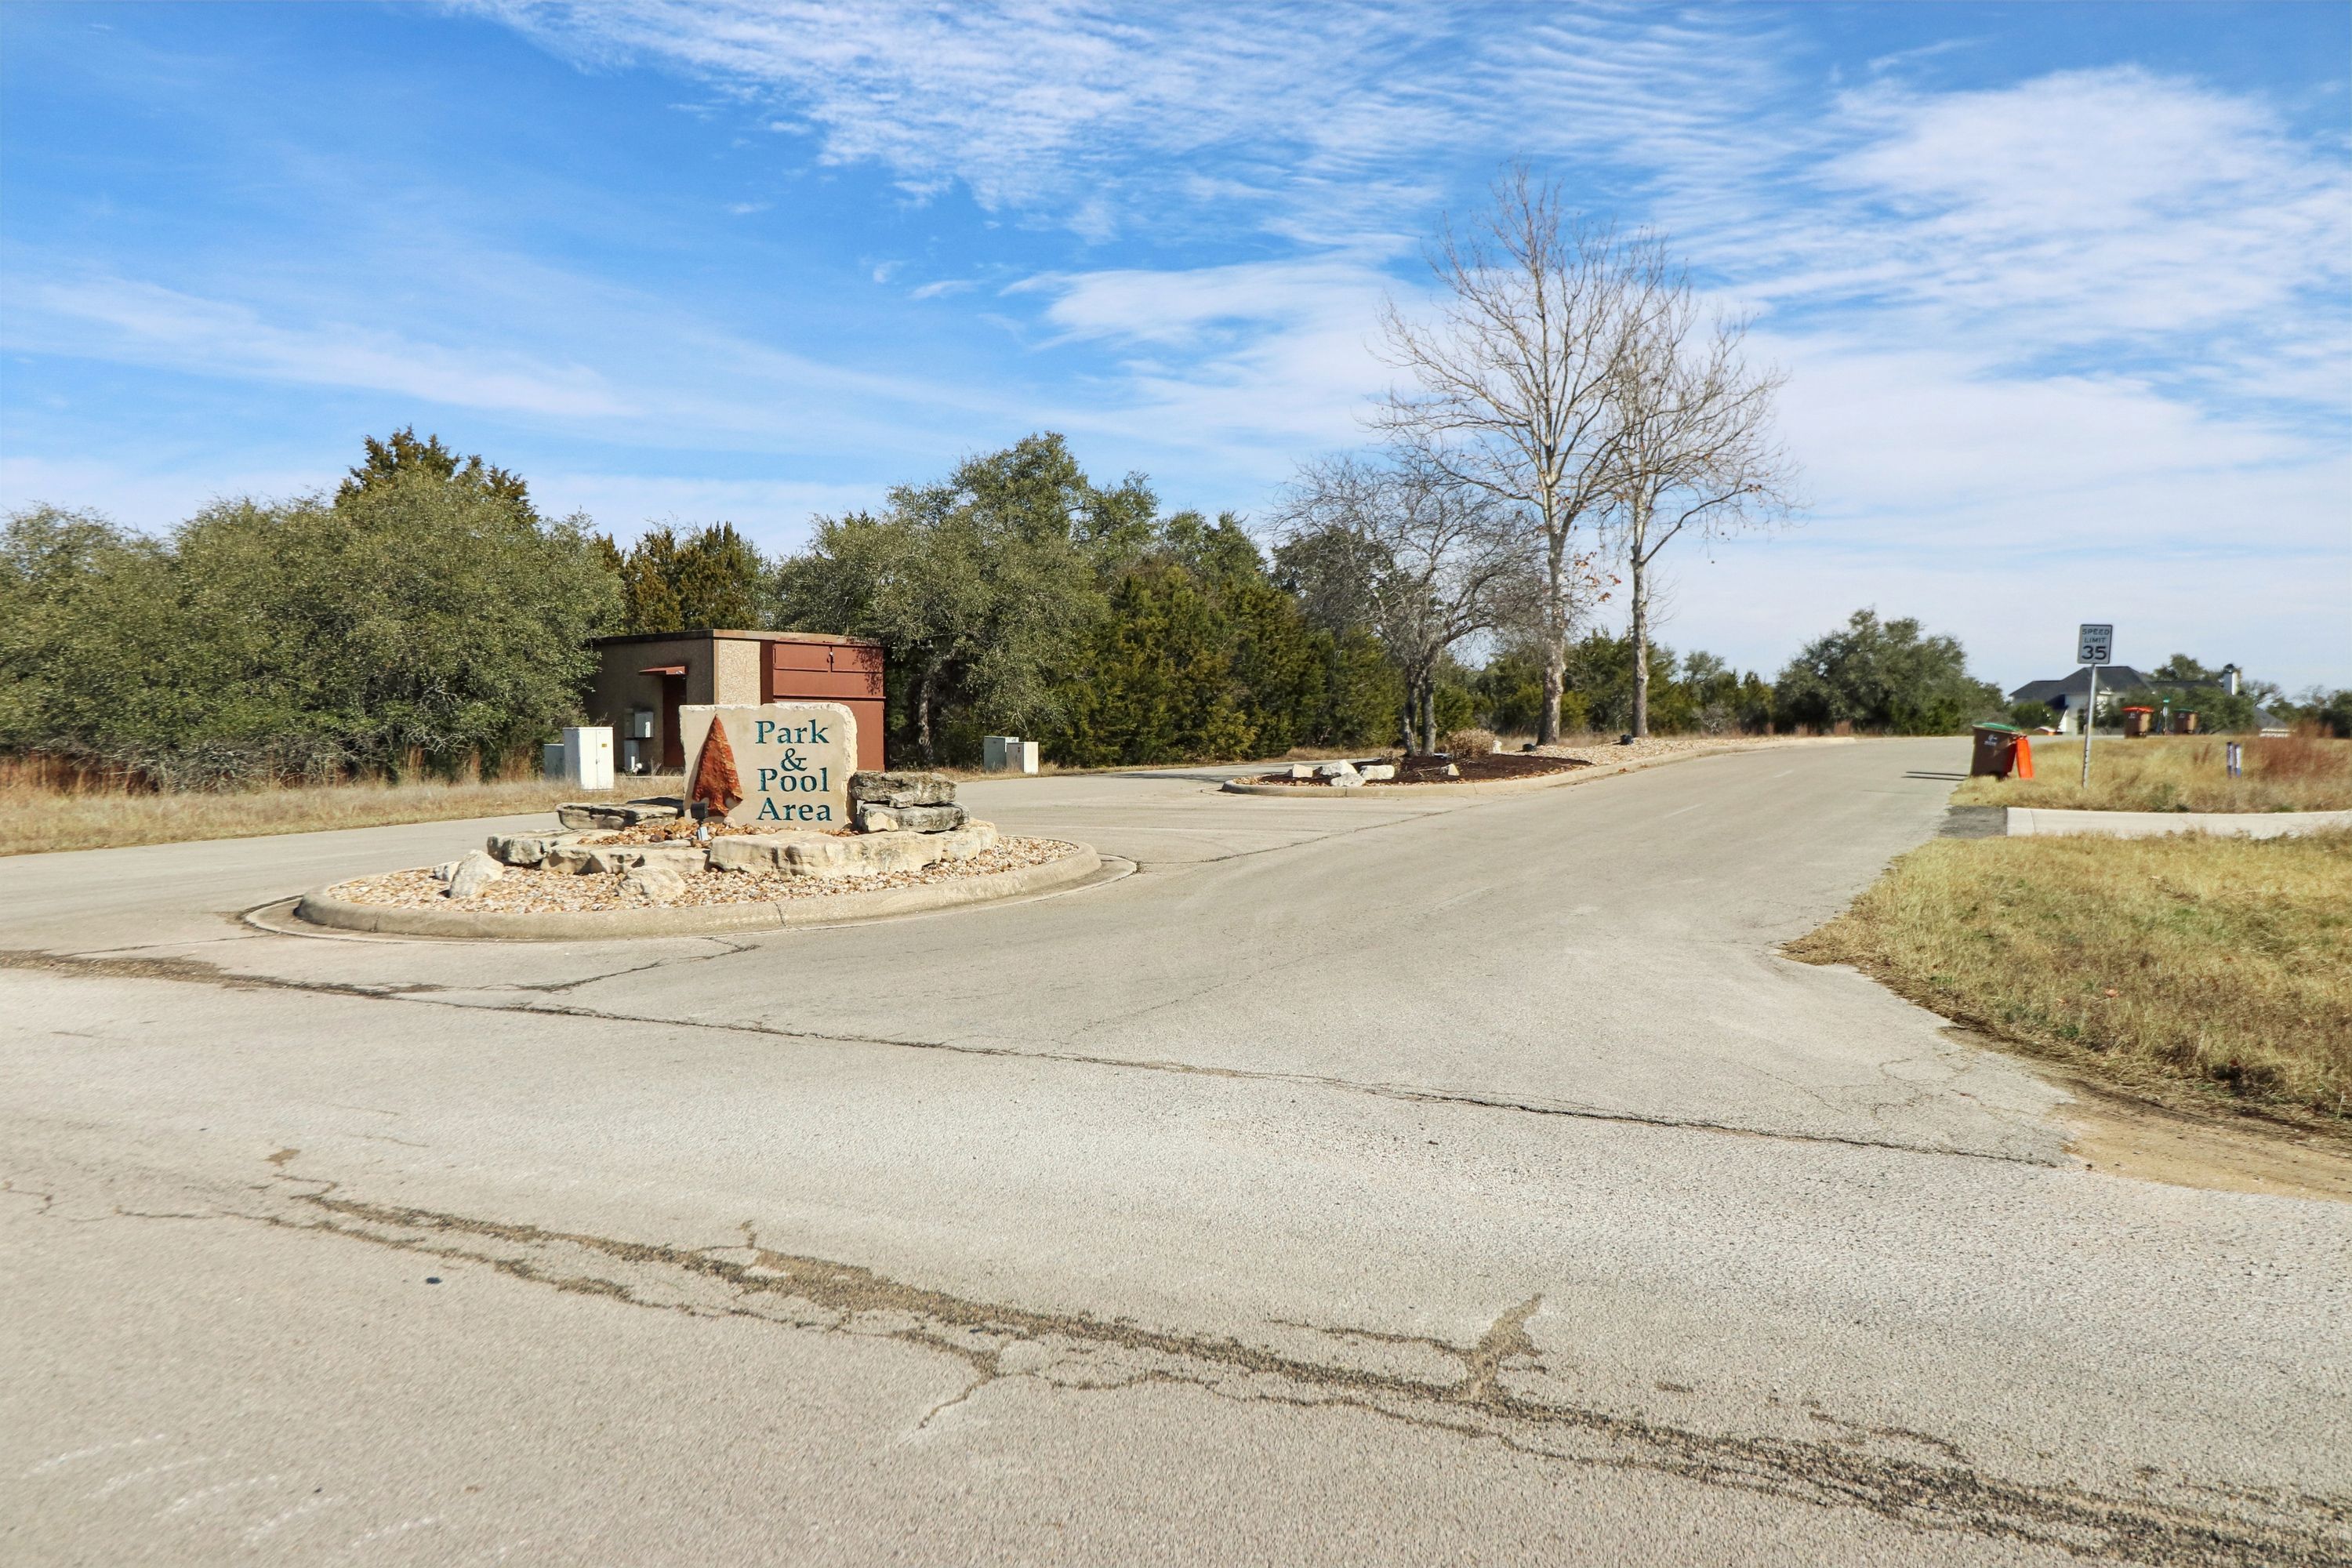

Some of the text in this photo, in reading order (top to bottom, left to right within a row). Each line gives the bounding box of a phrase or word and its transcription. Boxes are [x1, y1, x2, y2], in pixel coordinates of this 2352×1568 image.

[2082, 645, 2107, 660] 35
[754, 718, 830, 744] Park
[780, 747, 808, 771] &
[757, 767, 830, 793] Pool
[755, 797, 833, 822] Area
